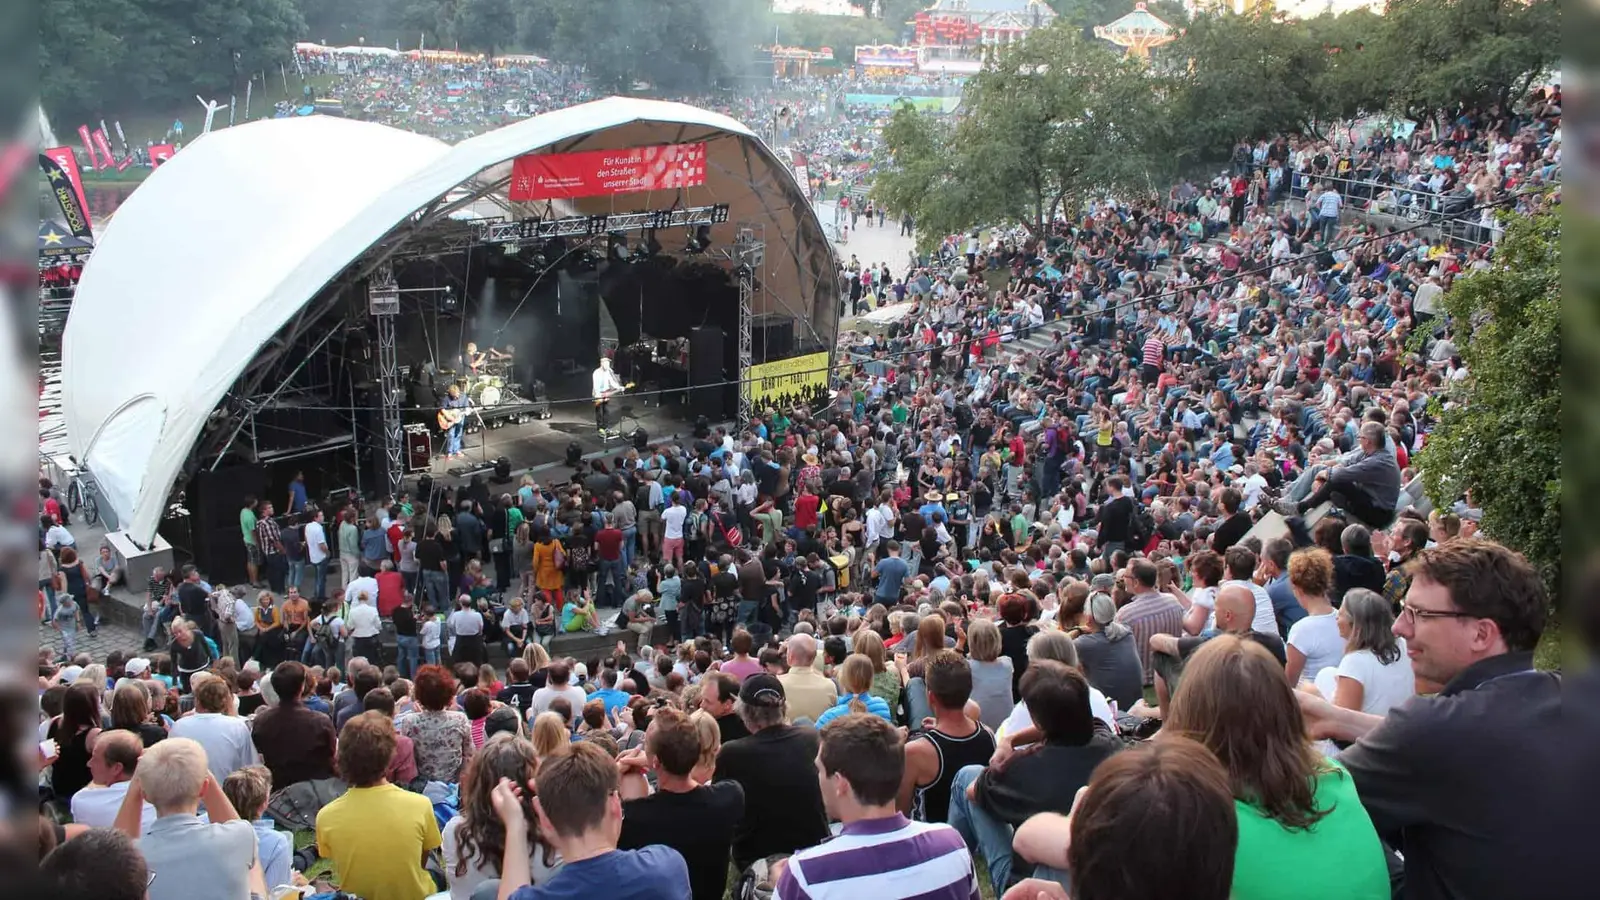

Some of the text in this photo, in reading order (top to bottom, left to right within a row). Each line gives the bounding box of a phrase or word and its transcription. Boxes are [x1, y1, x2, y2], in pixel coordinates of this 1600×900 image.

[604, 157, 614, 166] Für
[615, 156, 634, 165] Kunst
[597, 168, 610, 178] den
[603, 179, 628, 188] unserer
[510, 693, 520, 707] 4
